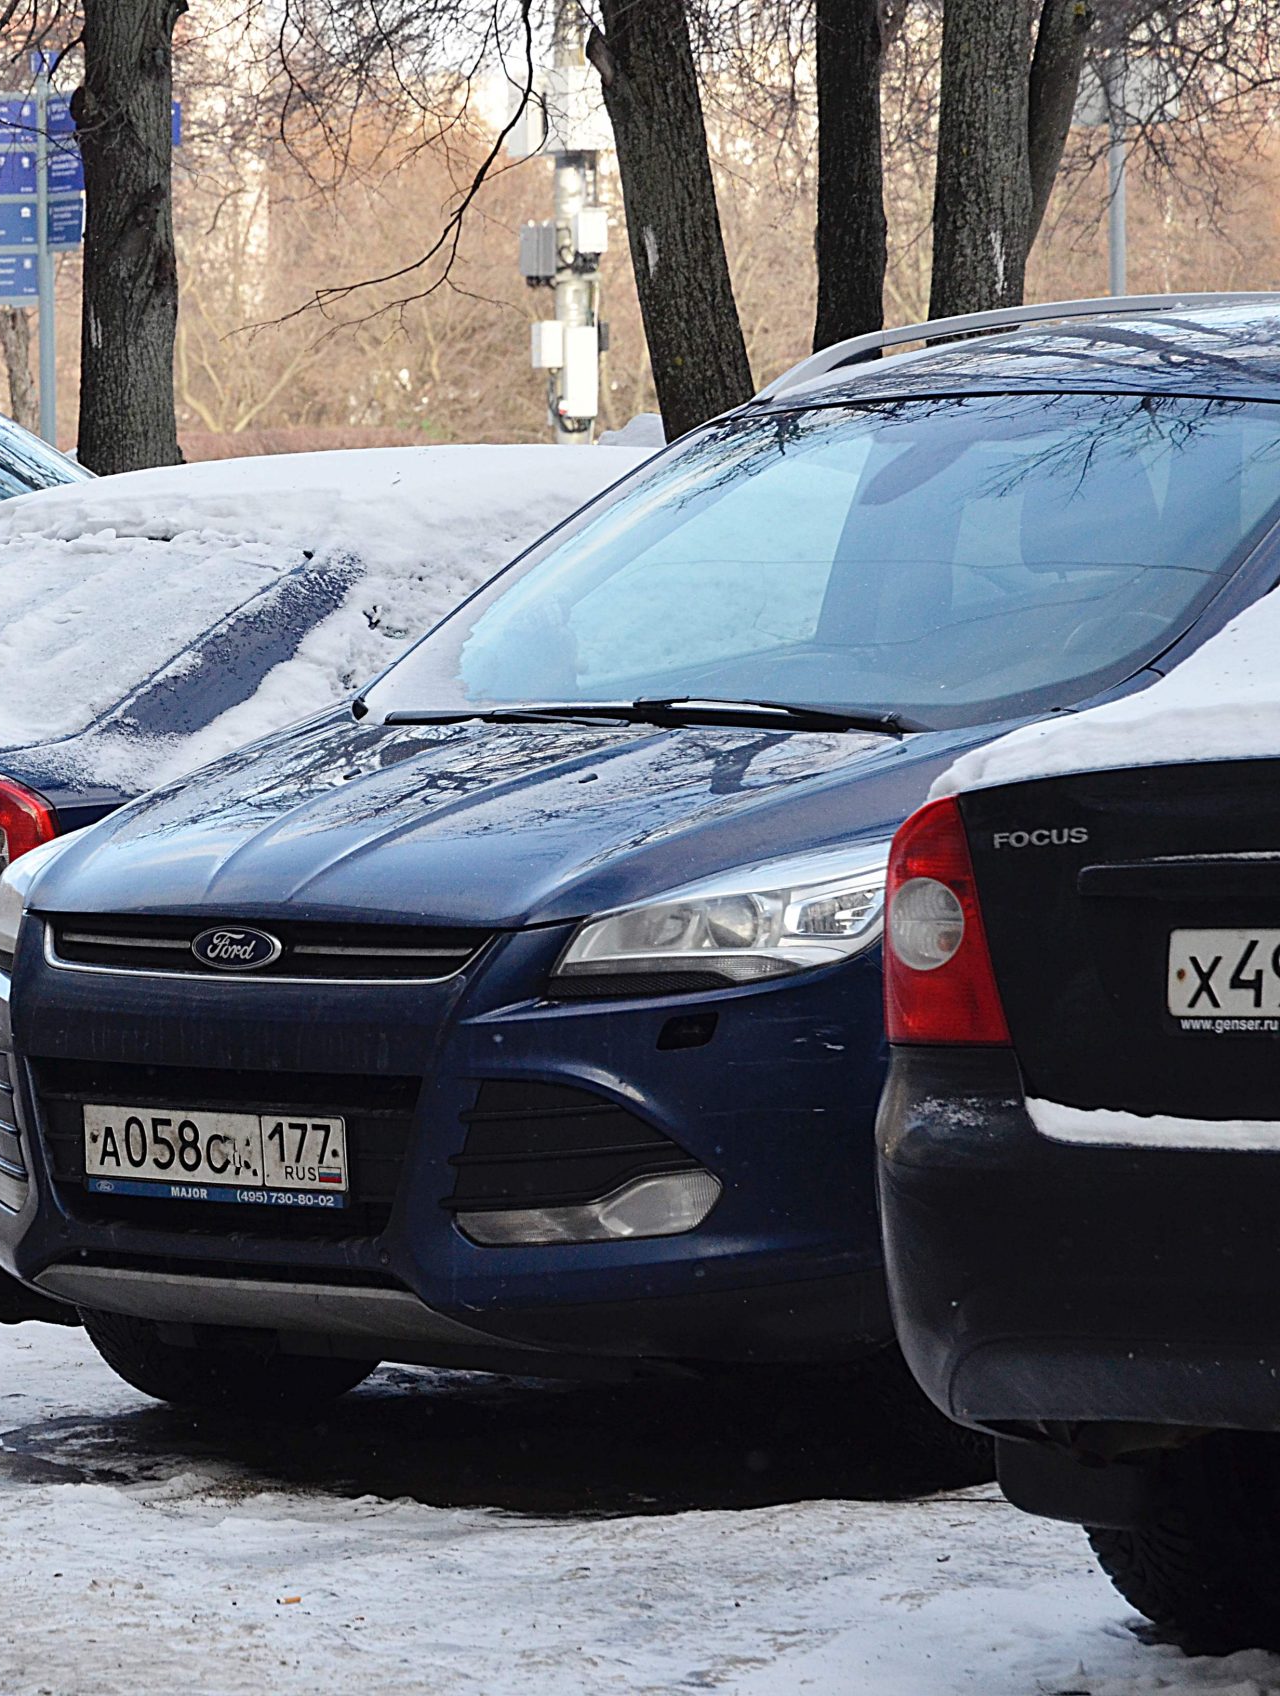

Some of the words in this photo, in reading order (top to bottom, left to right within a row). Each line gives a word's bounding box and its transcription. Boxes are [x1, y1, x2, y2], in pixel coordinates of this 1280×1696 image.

[993, 827, 1088, 848] FOCUS
[207, 931, 256, 959] Ford
[1180, 1018, 1278, 1034] www.genser.ru
[267, 1122, 331, 1165] 177
[285, 1166, 317, 1182] RUS
[171, 1186, 208, 1199] MAJOR
[236, 1189, 268, 1204] (495)
[270, 1192, 335, 1207] 730-80-02
